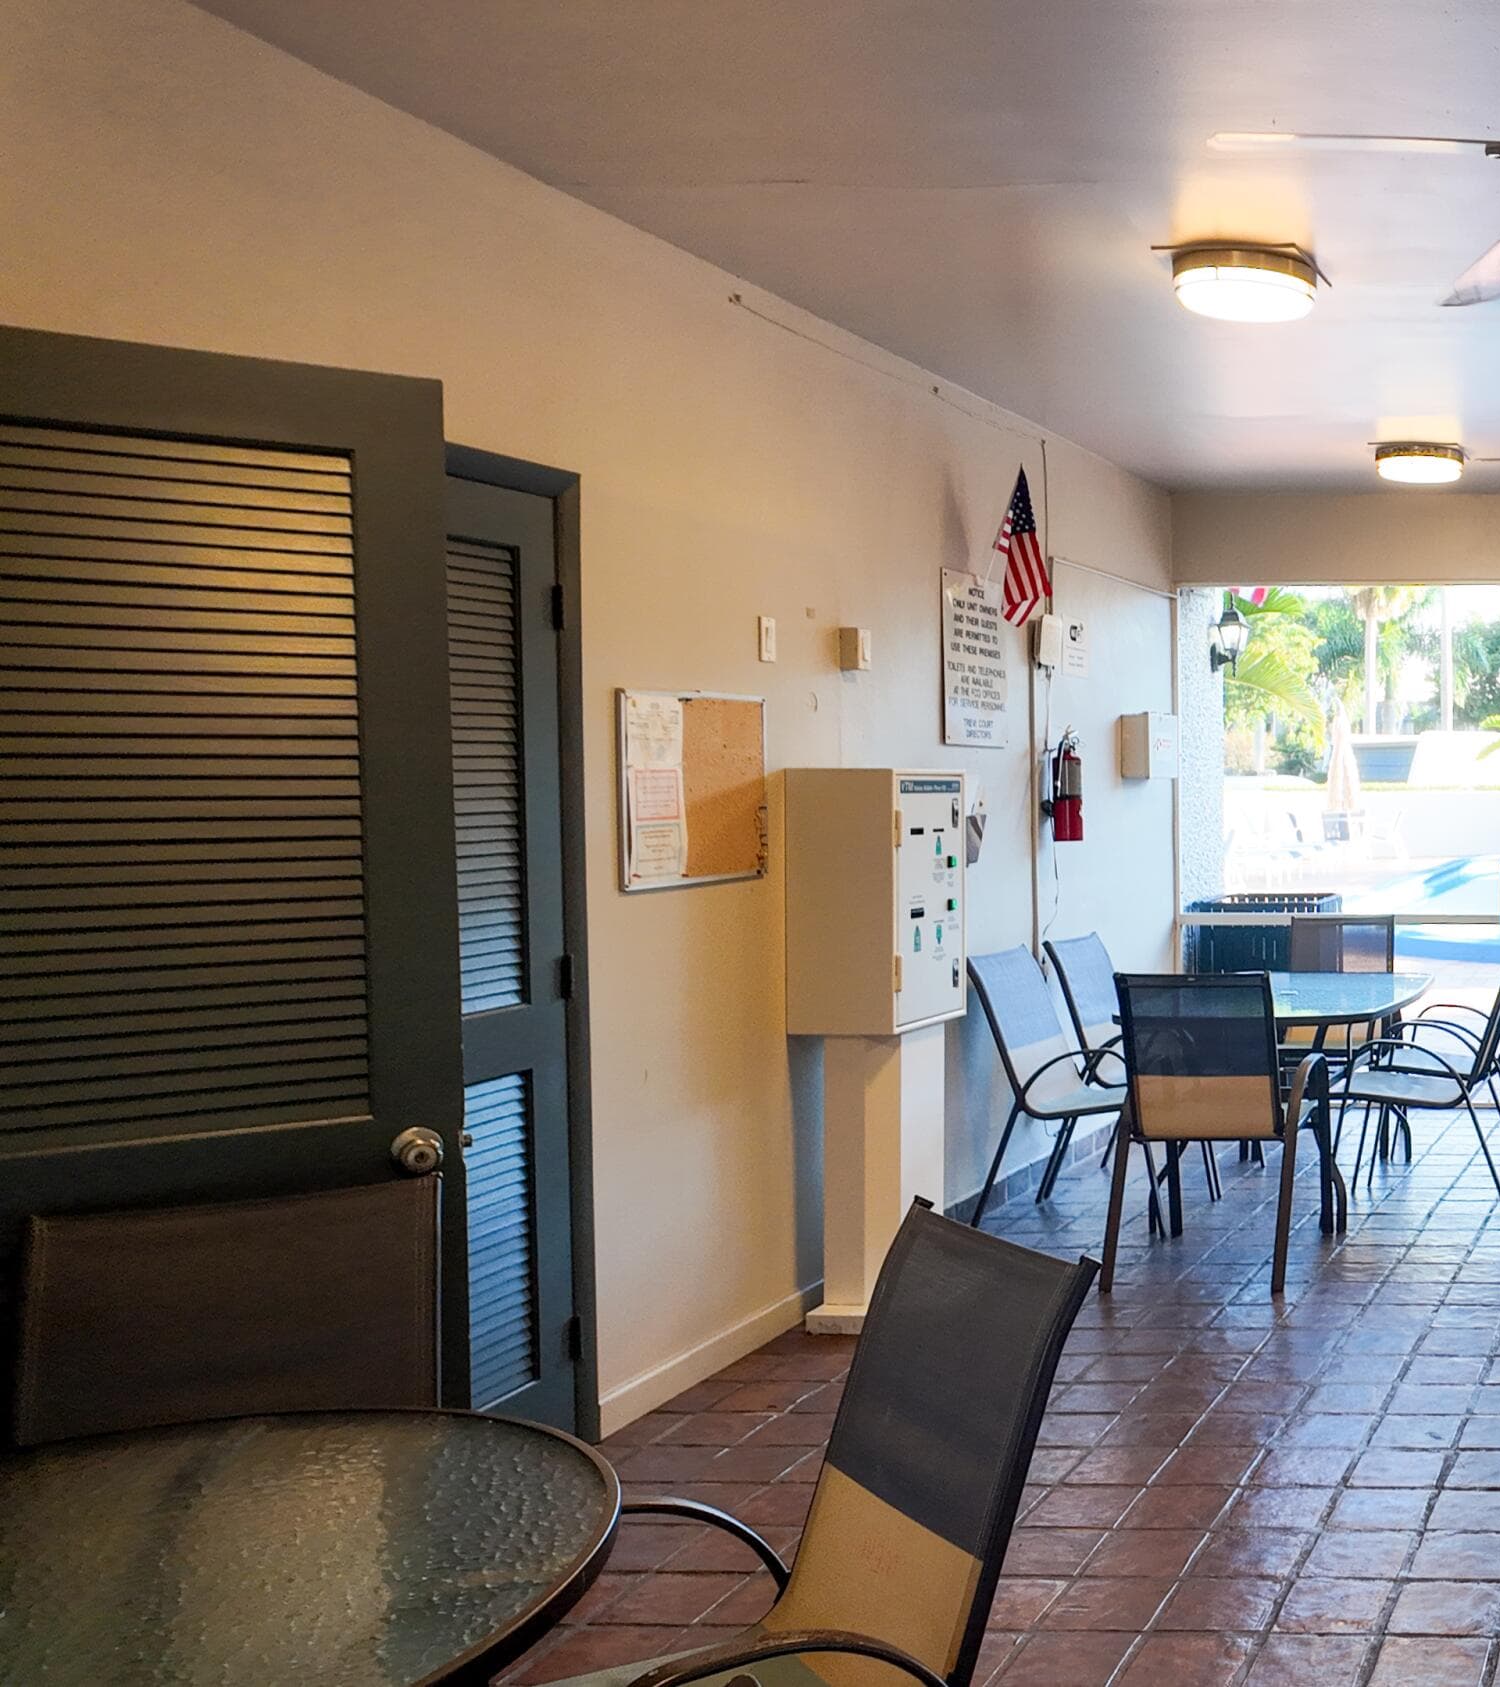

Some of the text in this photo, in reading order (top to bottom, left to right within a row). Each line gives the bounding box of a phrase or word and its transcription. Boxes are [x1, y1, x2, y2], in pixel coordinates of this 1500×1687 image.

[968, 587, 985, 600] NOTICE
[953, 598, 998, 617] ONLY UNIT OWNERS
[954, 612, 998, 631] AND THEIR GUESTS
[965, 629, 991, 644] PERMITTED
[962, 643, 977, 656] THESE
